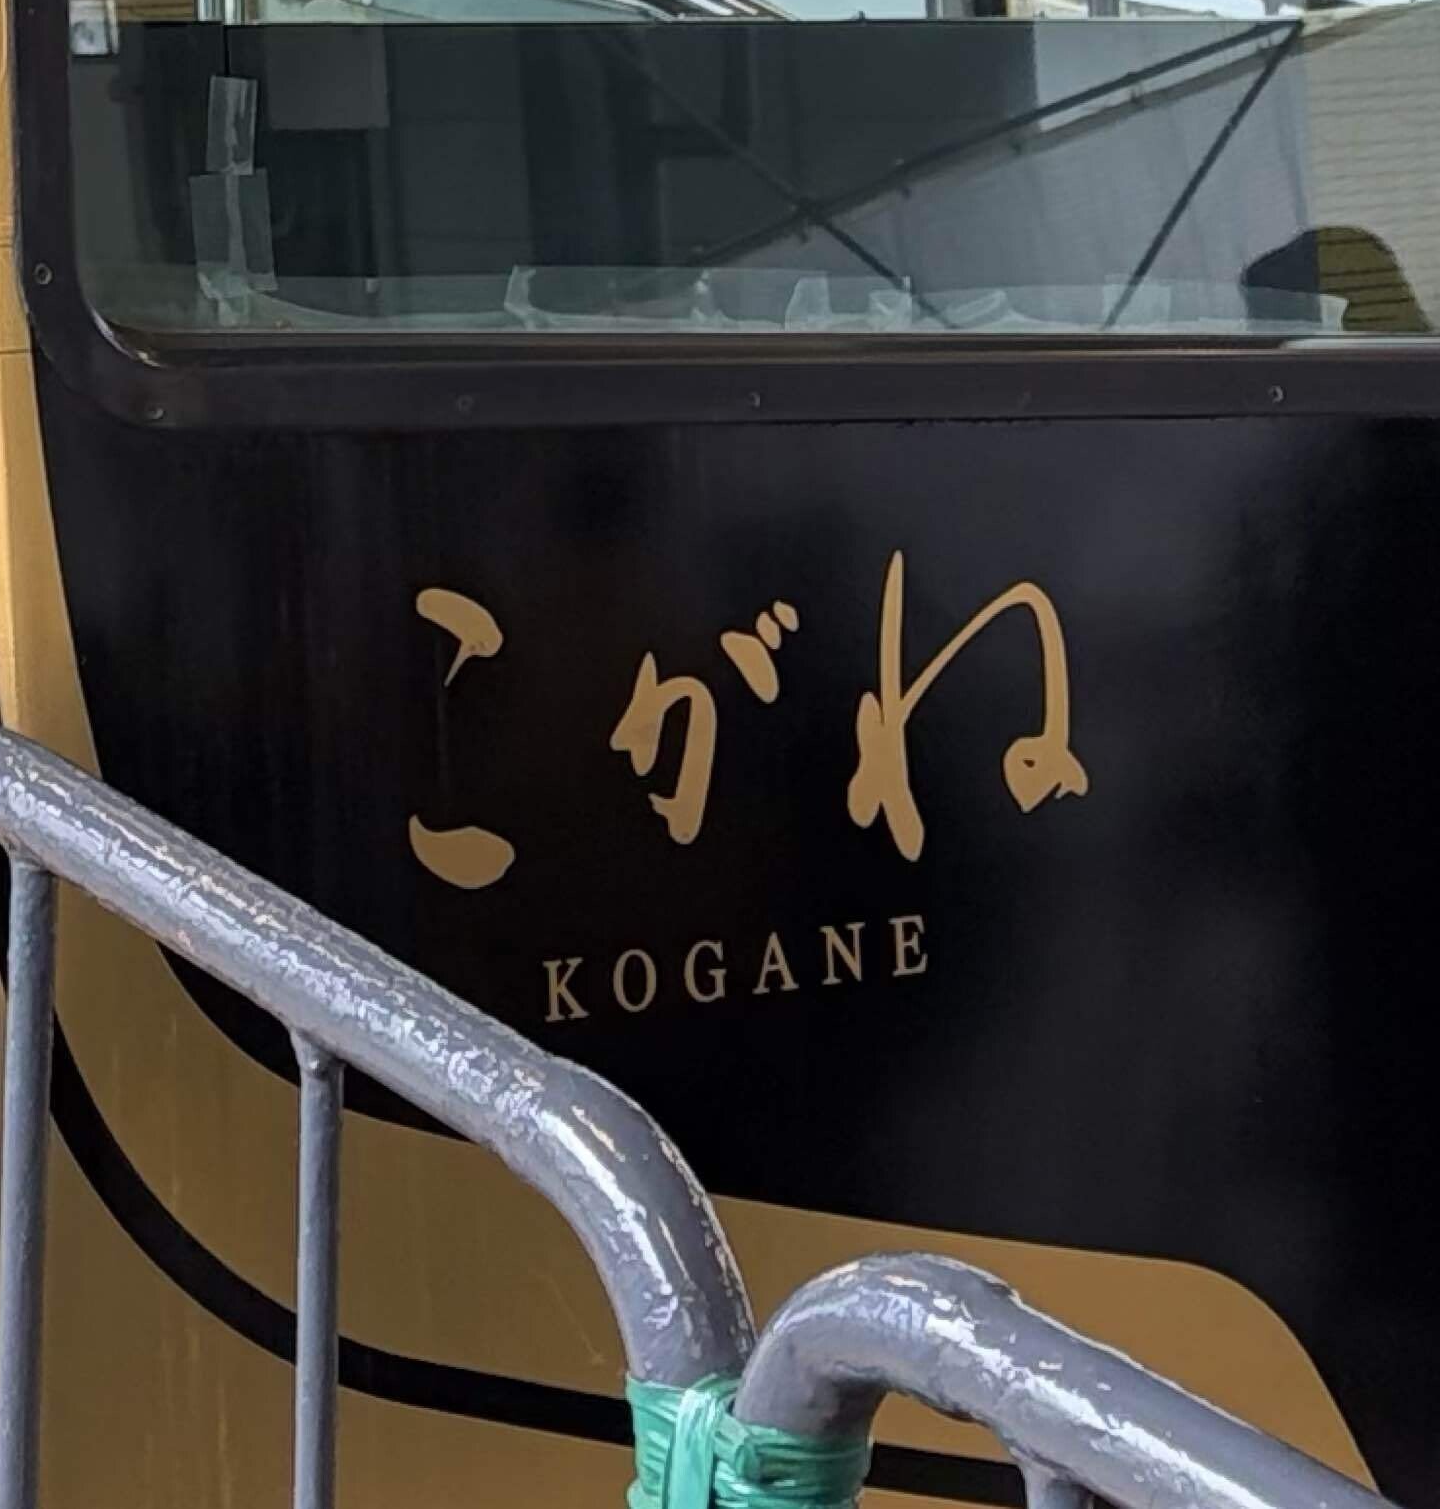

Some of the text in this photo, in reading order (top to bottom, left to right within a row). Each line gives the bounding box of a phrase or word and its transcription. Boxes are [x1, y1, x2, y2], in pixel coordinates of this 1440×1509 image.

[409, 551, 1088, 889] こがね
[544, 913, 928, 1023] KOGANE
